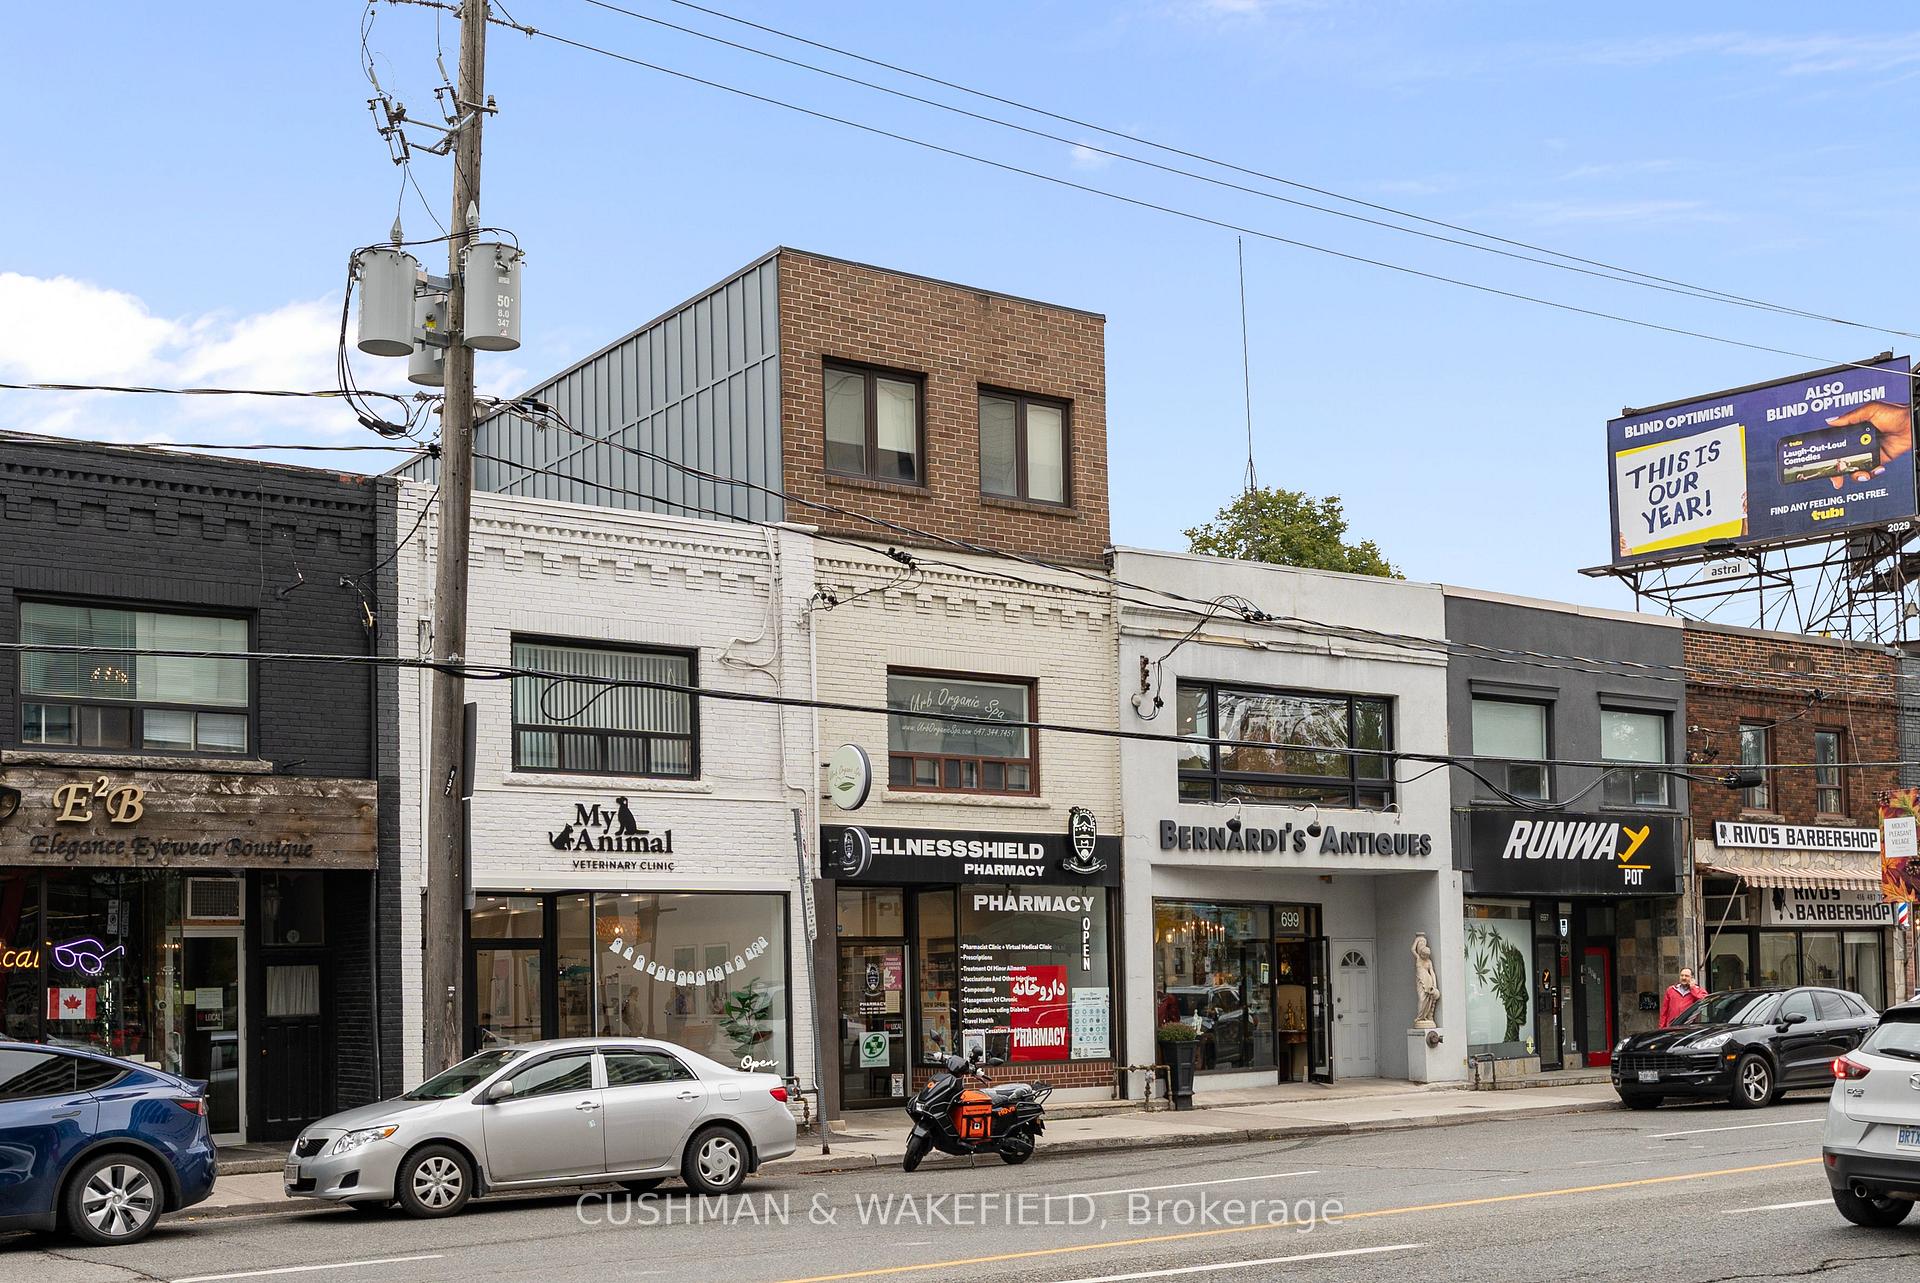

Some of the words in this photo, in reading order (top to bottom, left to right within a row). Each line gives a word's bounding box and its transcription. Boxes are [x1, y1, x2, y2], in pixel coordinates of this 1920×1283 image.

[498, 295, 510, 308] 50
[498, 310, 510, 318] 8.0
[498, 319, 510, 327] 347
[1805, 381, 1844, 401] ALSO
[1766, 402, 1808, 422] BLIND
[1811, 386, 1886, 412] OPTIMISM
[1624, 419, 1664, 439] BLIND
[1666, 404, 1734, 428] OPTIMISM
[1784, 440, 1846, 458] Laugh-Out-Loud
[1626, 453, 1694, 490] THIS
[1696, 440, 1722, 468] IS
[1784, 454, 1821, 465] Comedies
[1648, 472, 1698, 506] OUR
[1642, 490, 1712, 534] YEAR!
[1770, 505, 1789, 516] FIND
[1790, 502, 1808, 513] ANY
[1809, 496, 1845, 510] FEELING.
[1846, 492, 1864, 503] FOR
[1865, 488, 1888, 500] FREE.
[1812, 507, 1844, 521] tubi
[1888, 521, 1910, 532] 2029
[1711, 564, 1740, 576] astral
[938, 688, 980, 710] Organic
[985, 700, 1005, 720] Spa
[574, 803, 616, 834] My
[572, 829, 674, 854] Animal
[1320, 826, 1432, 856] ANTIQUES
[1502, 820, 1650, 862] RUNWAY
[1733, 826, 1779, 845] RIVO'S
[1786, 828, 1878, 848] BARBERSHOP
[30, 834, 126, 862] Elegance
[131, 836, 221, 862] Eyewear
[225, 838, 314, 864] Boutique
[868, 837, 1044, 860] ELLNESSSHIELD
[572, 860, 637, 870] VETERINARY
[640, 861, 675, 871] CLINIC
[964, 863, 1045, 877] PHARMACY
[1624, 869, 1642, 885] POT
[974, 894, 1095, 912] PHARMACY
[1796, 904, 1890, 921] BARBERSHOP
[1281, 912, 1299, 928] 699
[1082, 917, 1091, 971] OPEN
[0, 950, 40, 968] cal
[1012, 979, 1065, 1001] داروخانه
[1014, 1027, 1066, 1048] PHARMACY
[740, 1055, 779, 1073] Open
